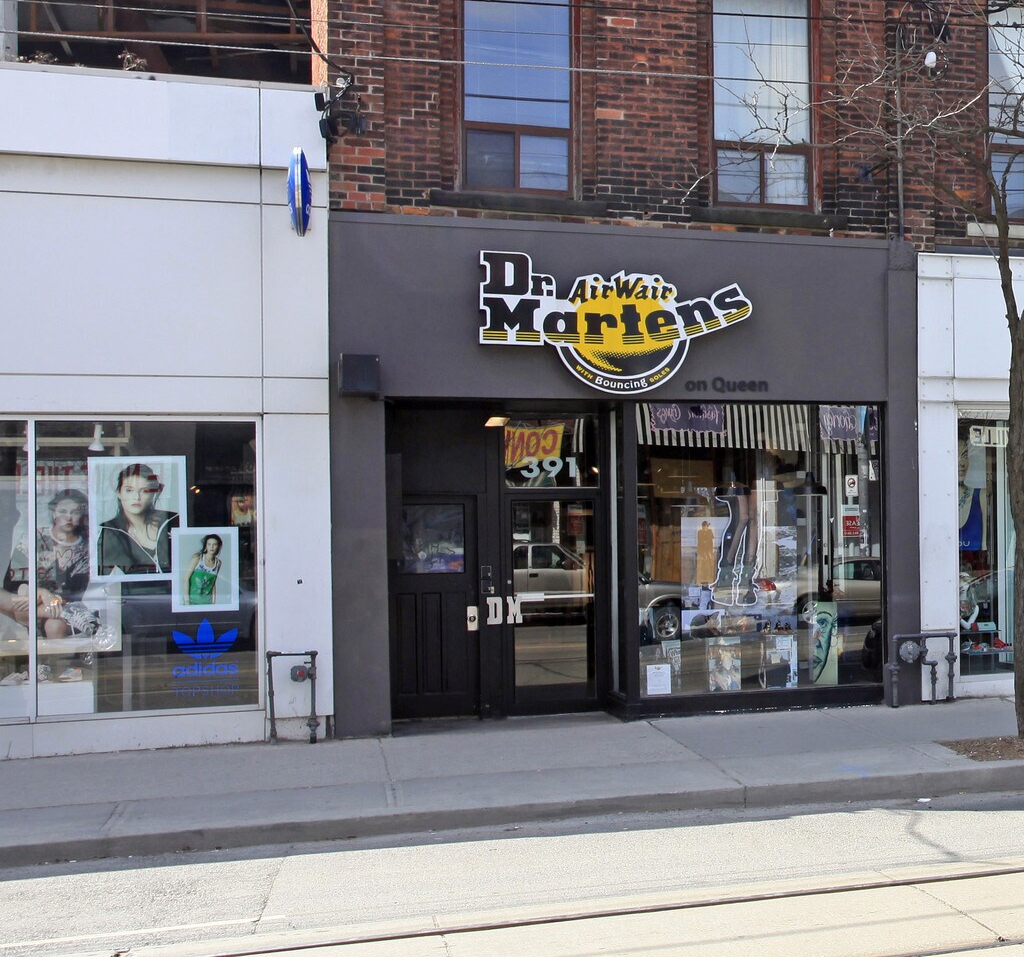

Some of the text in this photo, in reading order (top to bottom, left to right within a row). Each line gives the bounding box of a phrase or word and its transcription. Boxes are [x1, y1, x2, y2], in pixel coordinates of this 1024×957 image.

[481, 251, 555, 298] Dr.
[568, 273, 674, 305] AirWair
[481, 285, 751, 345] Martens
[576, 364, 671, 390] WITH Bouncing SOLES
[685, 377, 768, 394] on Queen
[520, 456, 577, 479] 391
[172, 662, 239, 679] adidas
[171, 684, 240, 698] TOPSHOP
